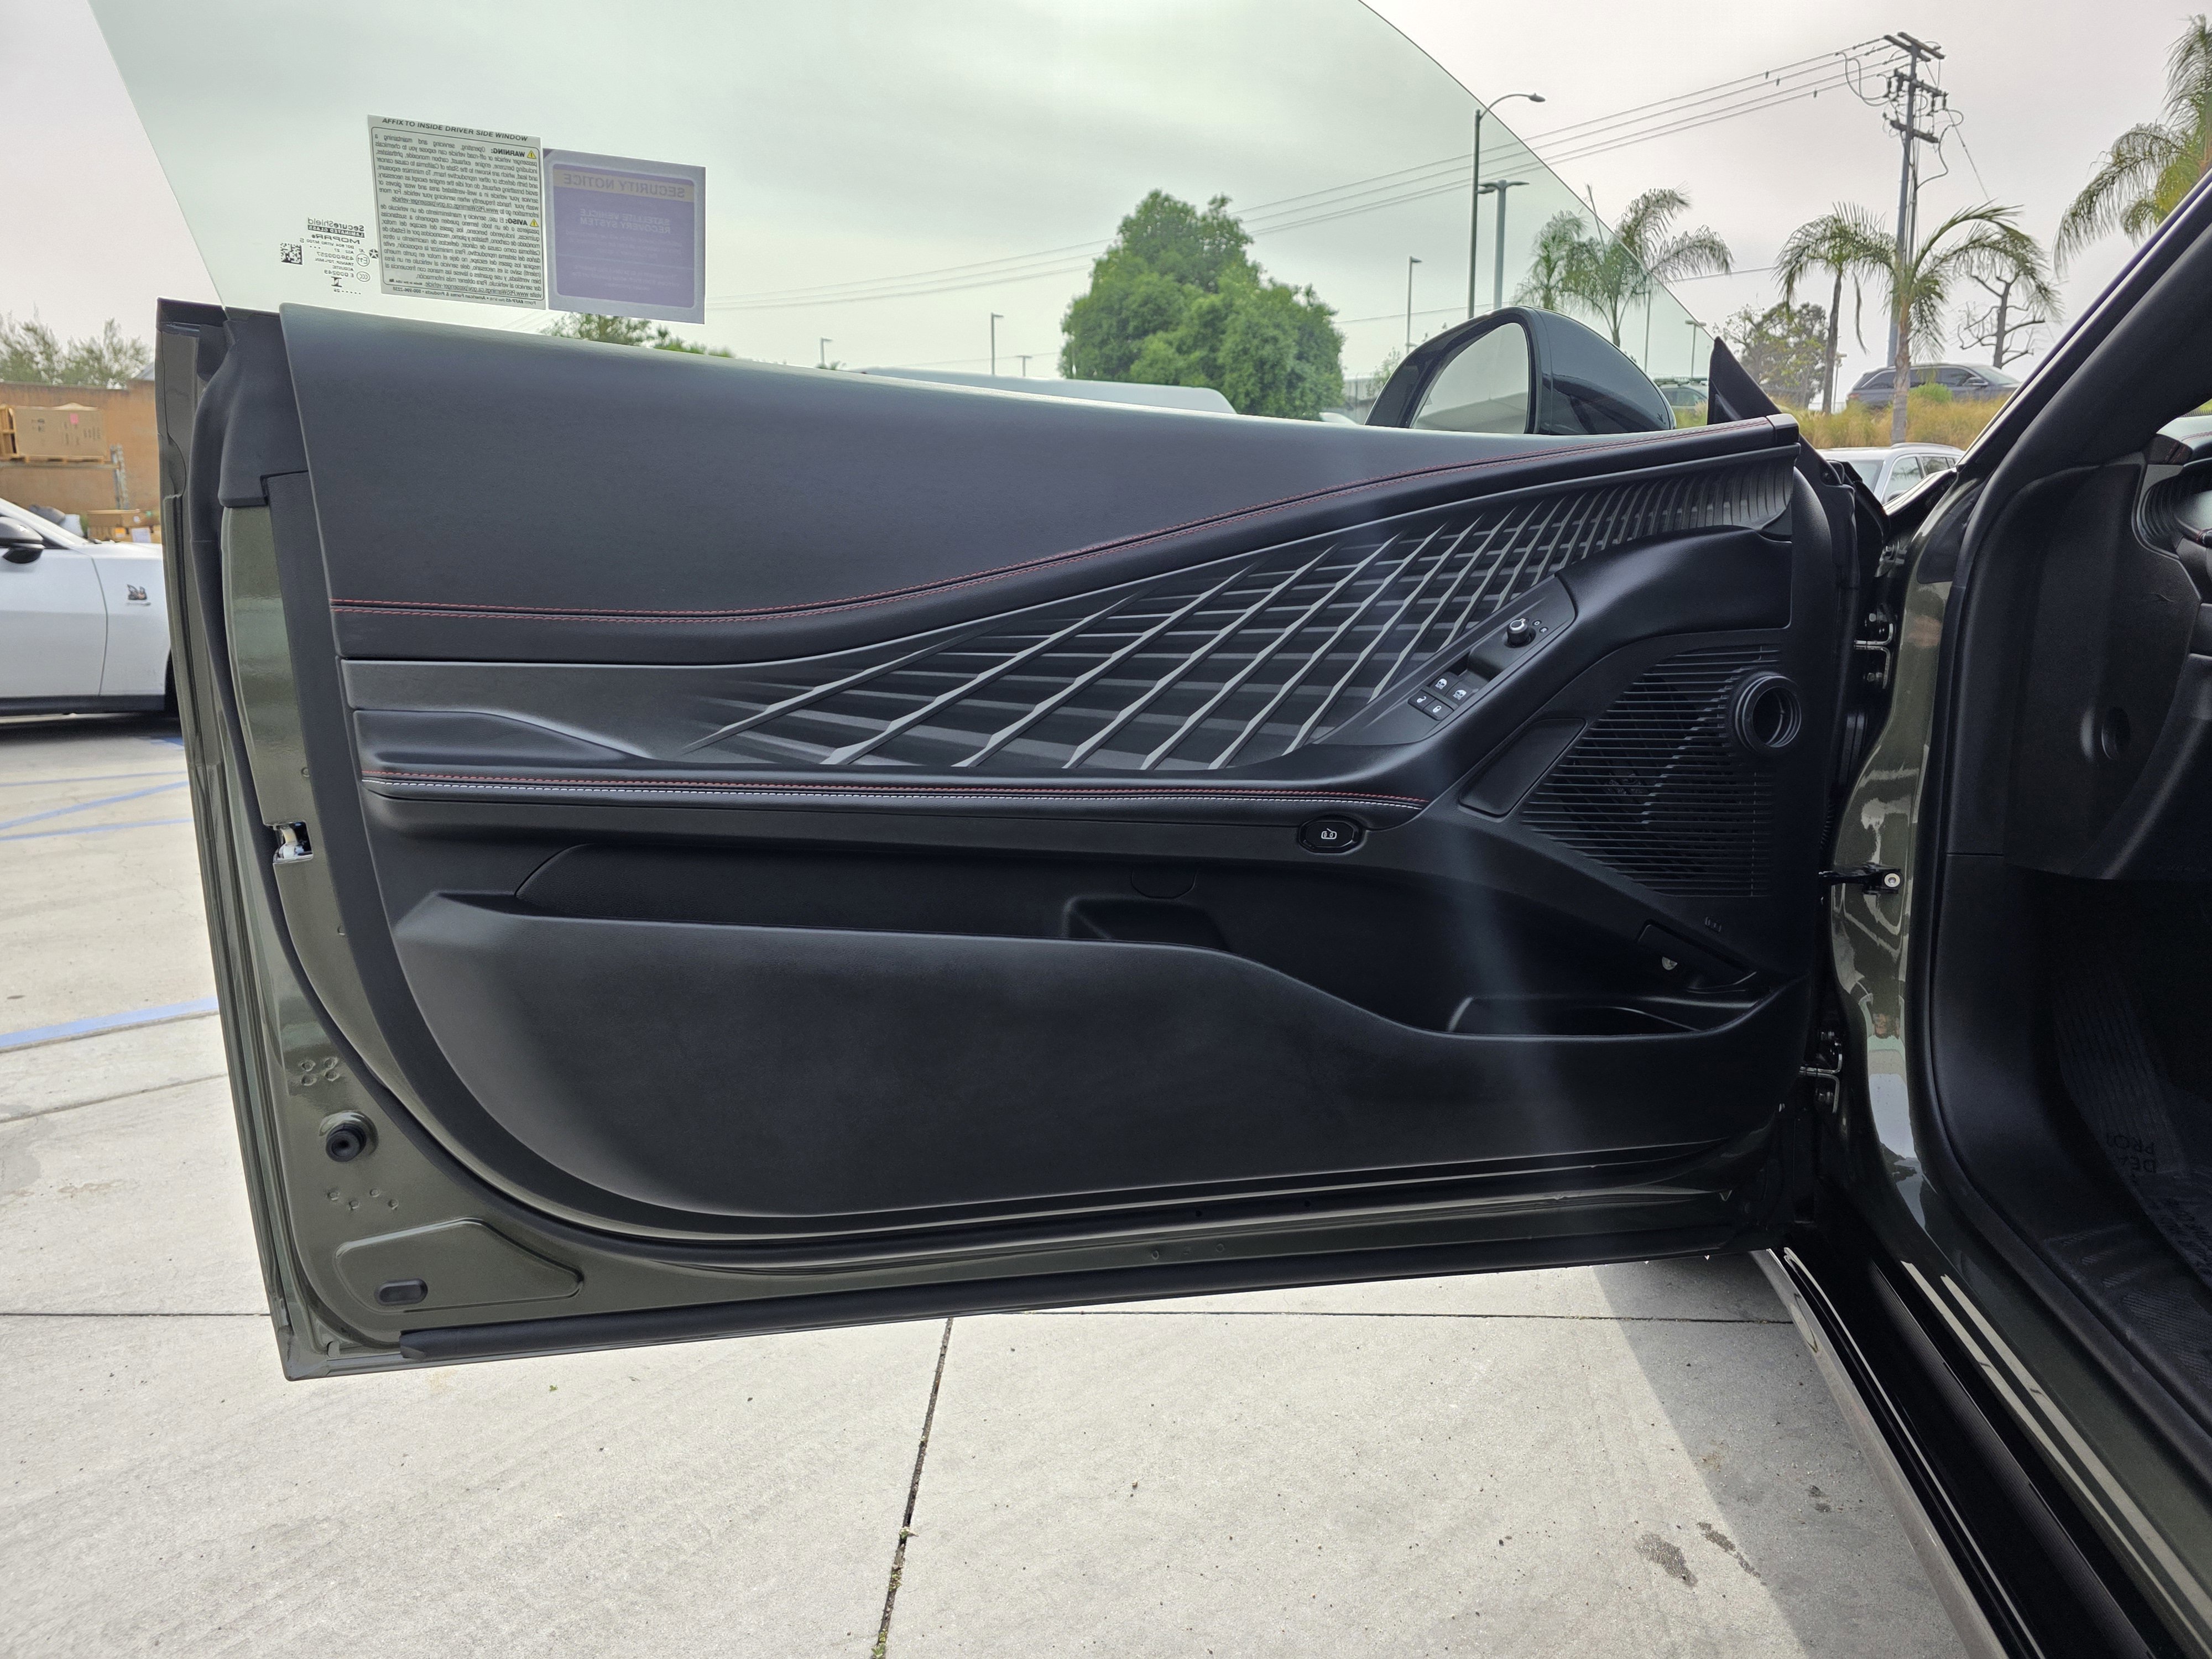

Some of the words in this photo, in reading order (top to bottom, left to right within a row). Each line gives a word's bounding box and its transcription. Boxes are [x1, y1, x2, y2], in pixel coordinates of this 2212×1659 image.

[382, 118, 404, 126] AFFIX
[417, 122, 444, 131] INSIDE
[445, 126, 474, 135] DRIVER
[495, 132, 528, 142] WINDOW
